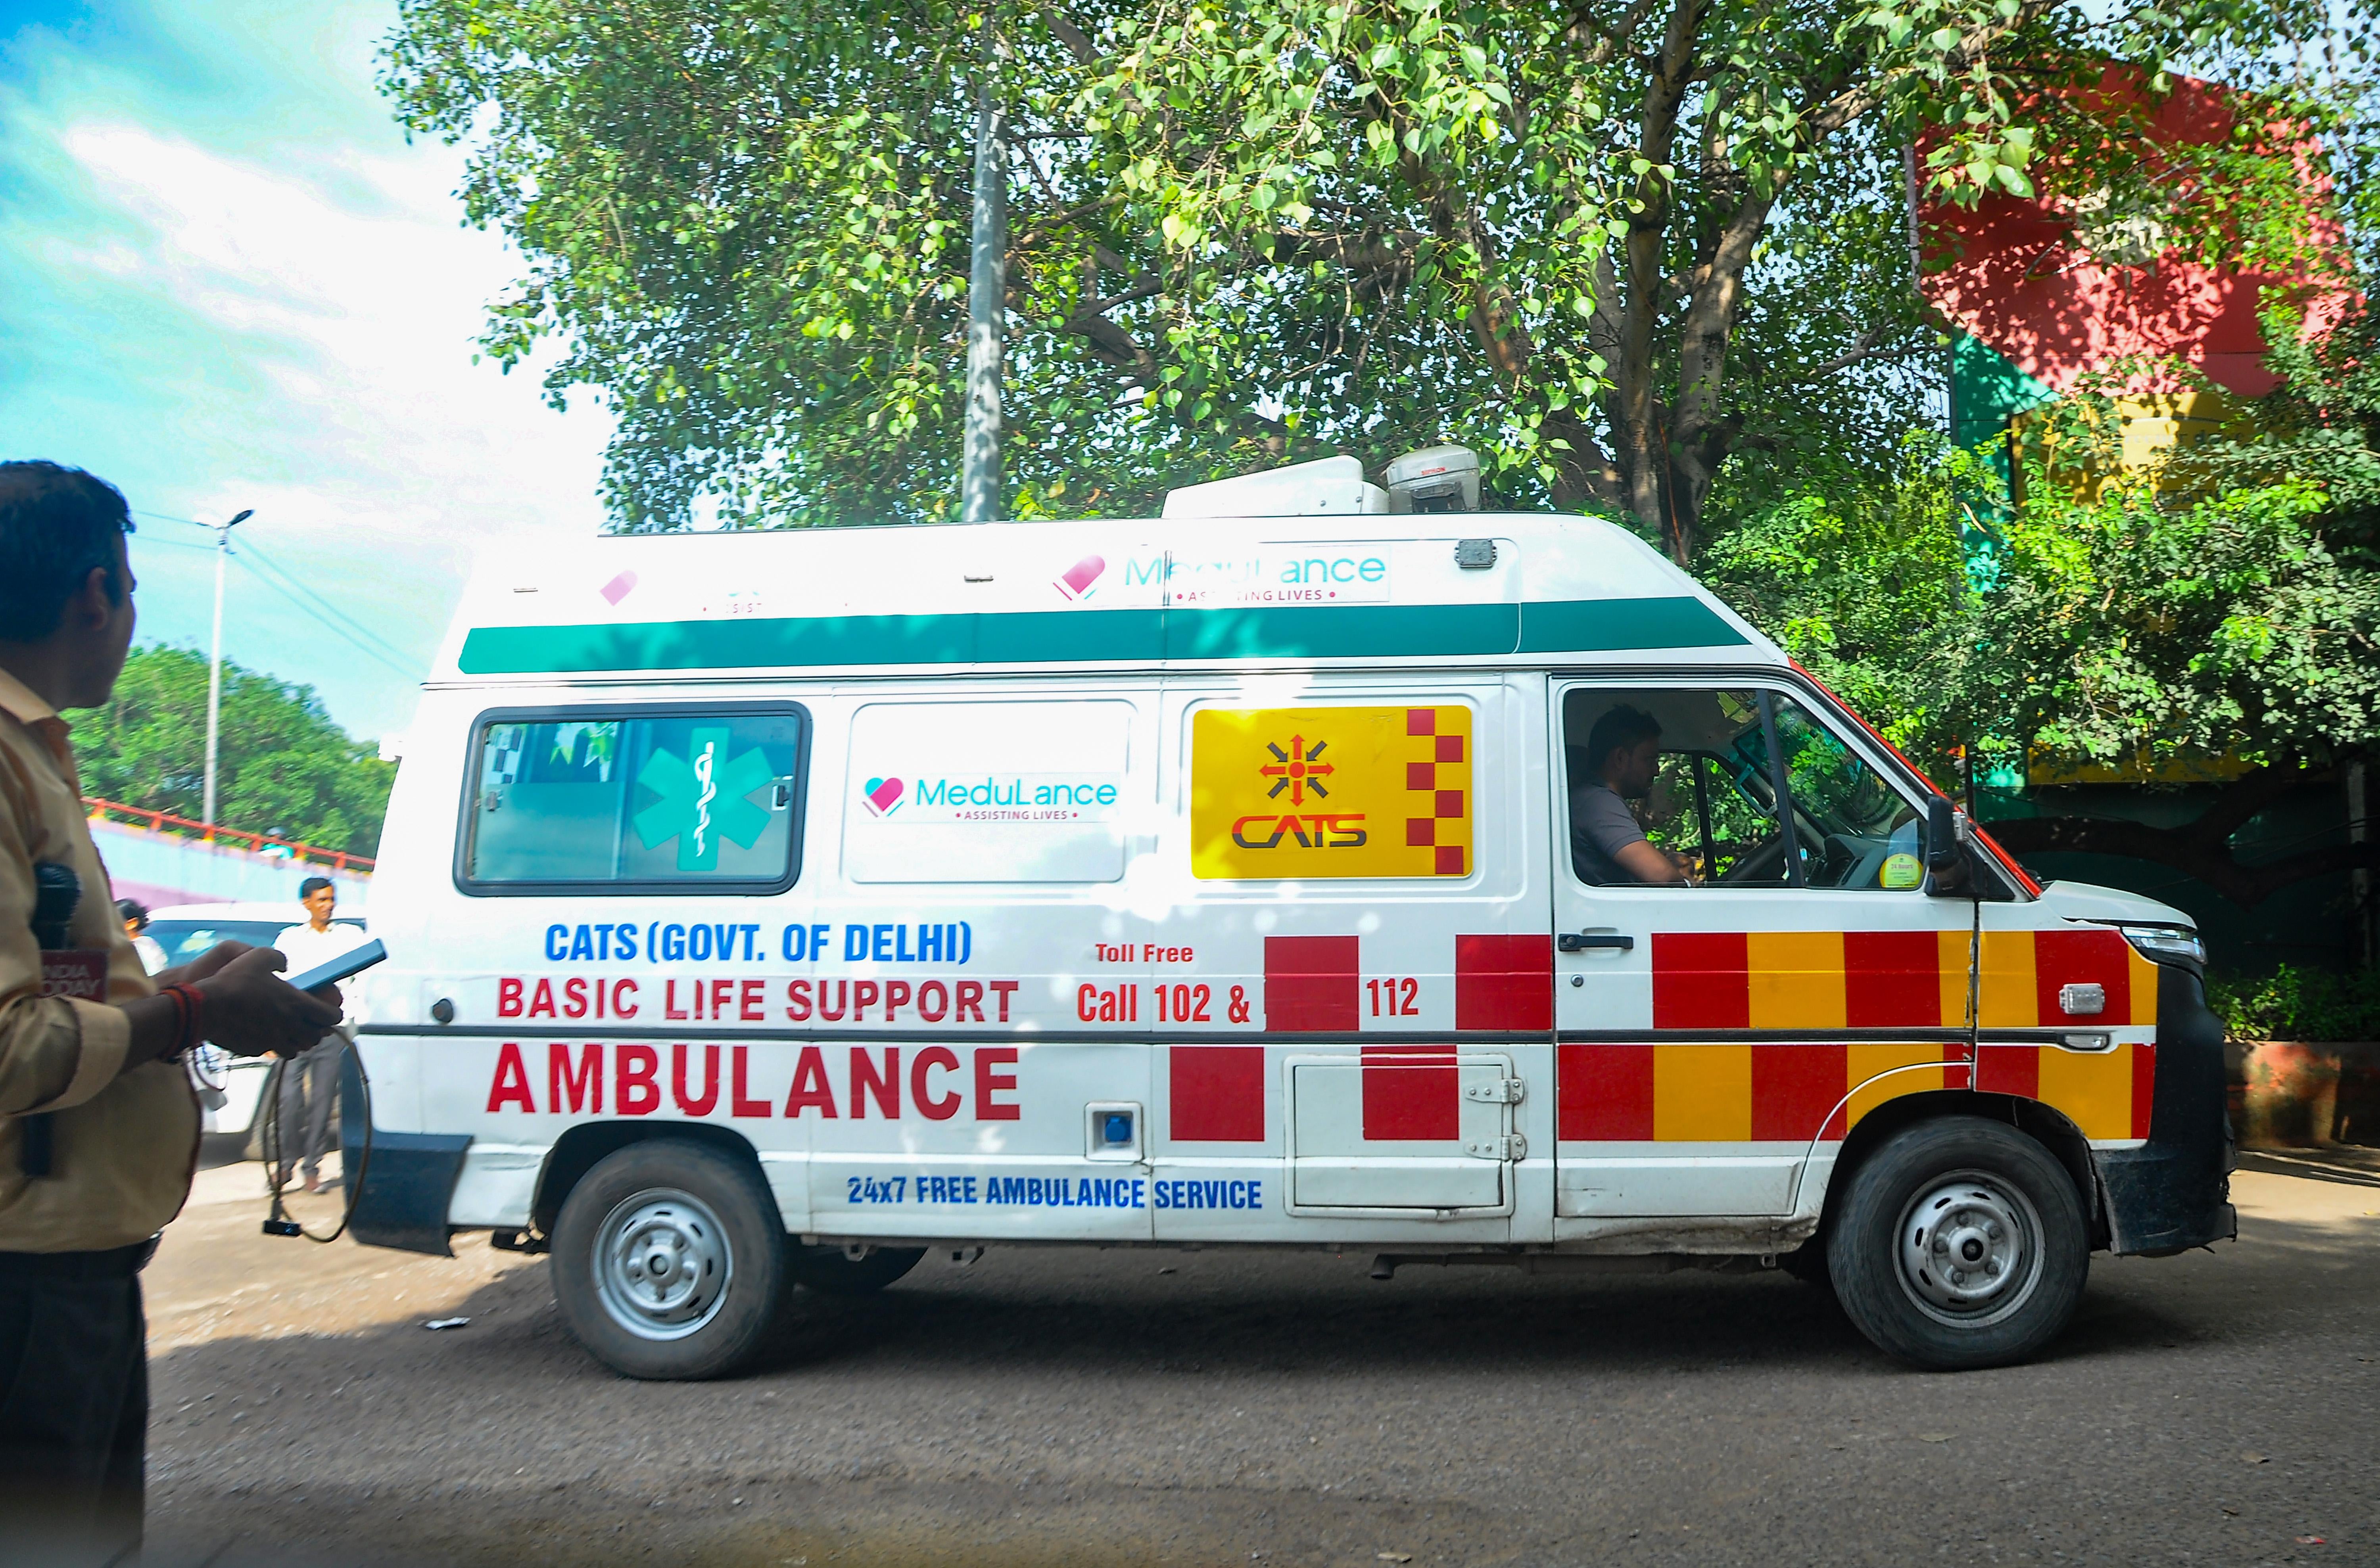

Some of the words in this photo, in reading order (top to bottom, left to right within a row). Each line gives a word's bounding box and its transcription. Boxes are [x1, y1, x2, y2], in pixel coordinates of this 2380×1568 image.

[1278, 590, 1322, 600] LIVES
[917, 777, 1117, 805] MeduLance
[964, 811, 1028, 820] ASSISTING
[1033, 811, 1067, 820] LIVES
[1232, 814, 1367, 848] CATS
[545, 923, 638, 962] CATS
[647, 921, 765, 964] (GOVT.
[782, 924, 831, 962] OF
[844, 920, 972, 965] DELHI)
[1096, 943, 1134, 962] Toll
[1144, 944, 1194, 962] Free
[42, 964, 89, 978] NDIA
[41, 979, 101, 995] ODAY
[498, 978, 639, 1018] BASIC
[666, 980, 764, 1020] LIFE
[787, 980, 1018, 1022] SUPPORT
[1078, 983, 1137, 1022] Call
[1155, 984, 1211, 1022] 102
[1228, 985, 1250, 1023] &
[1367, 978, 1419, 1016] 112
[487, 1043, 1020, 1120] AMBULANCE
[847, 1176, 907, 1204] 24x7
[915, 1177, 978, 1204] FREE
[985, 1178, 1145, 1208] AMBULANCE
[1154, 1180, 1263, 1209] SERVICE
